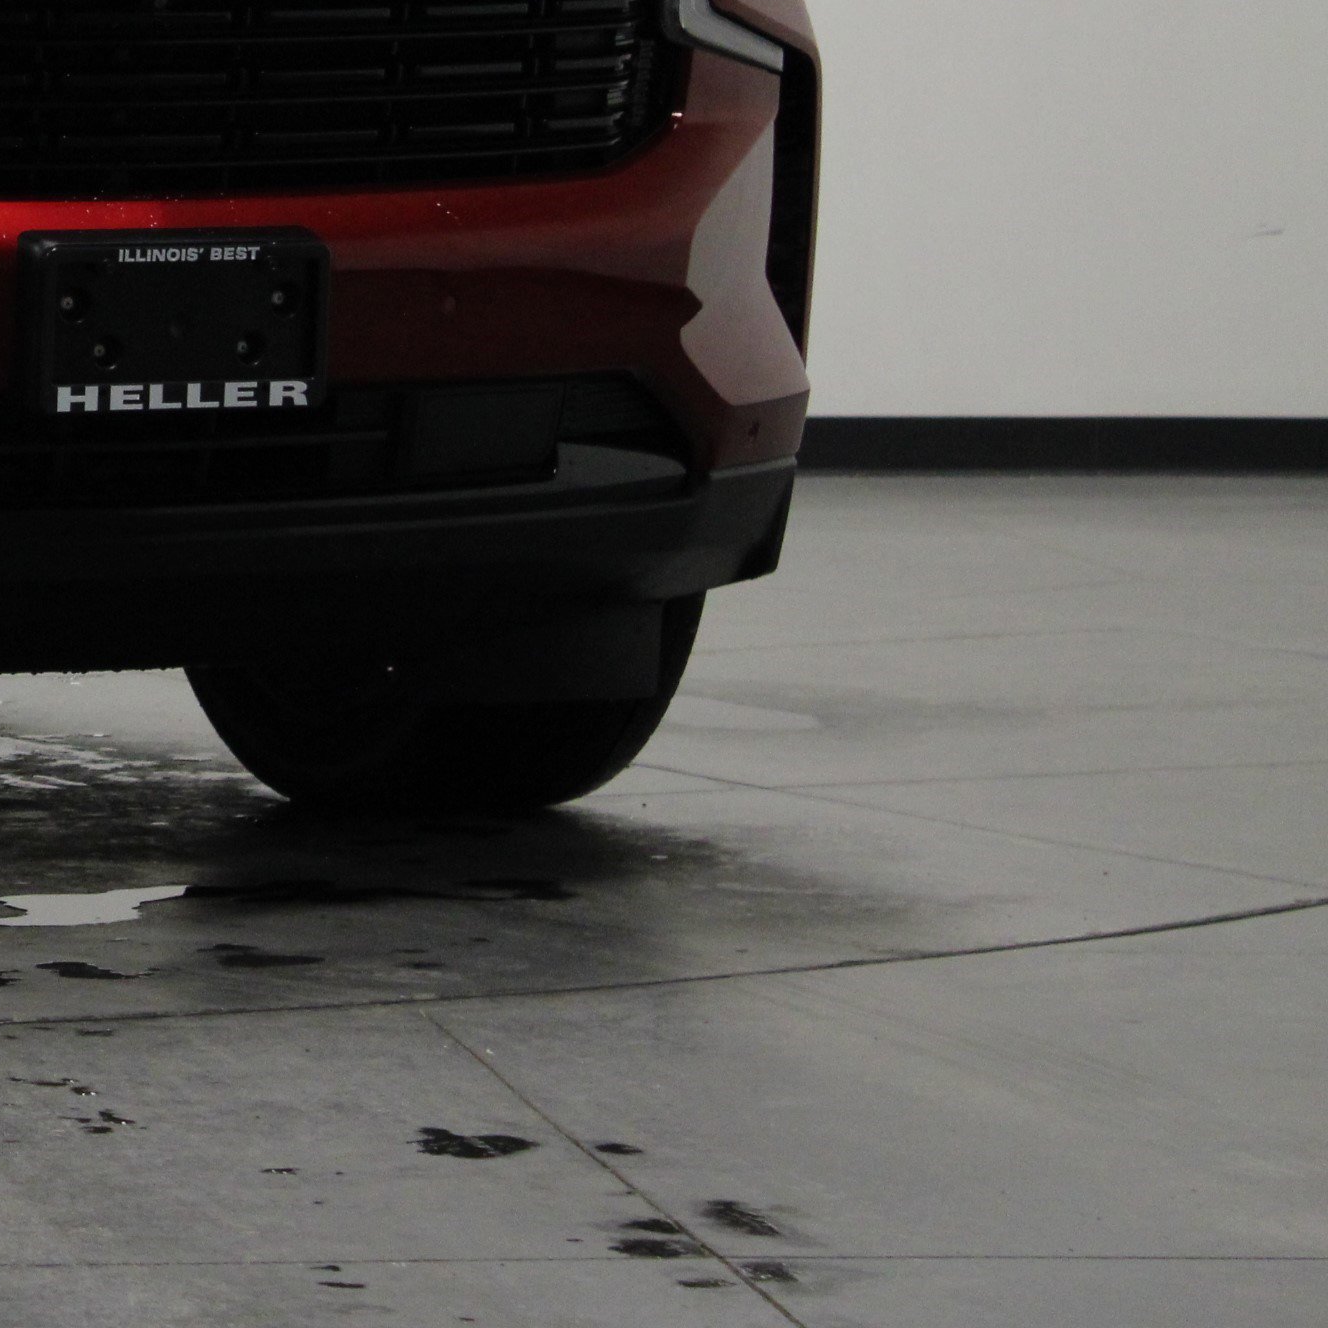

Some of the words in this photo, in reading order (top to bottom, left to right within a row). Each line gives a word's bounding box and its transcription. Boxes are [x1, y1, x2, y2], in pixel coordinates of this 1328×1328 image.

[118, 247, 204, 263] ILLINOIS'
[210, 246, 261, 261] BEST
[57, 380, 308, 413] HELLER
